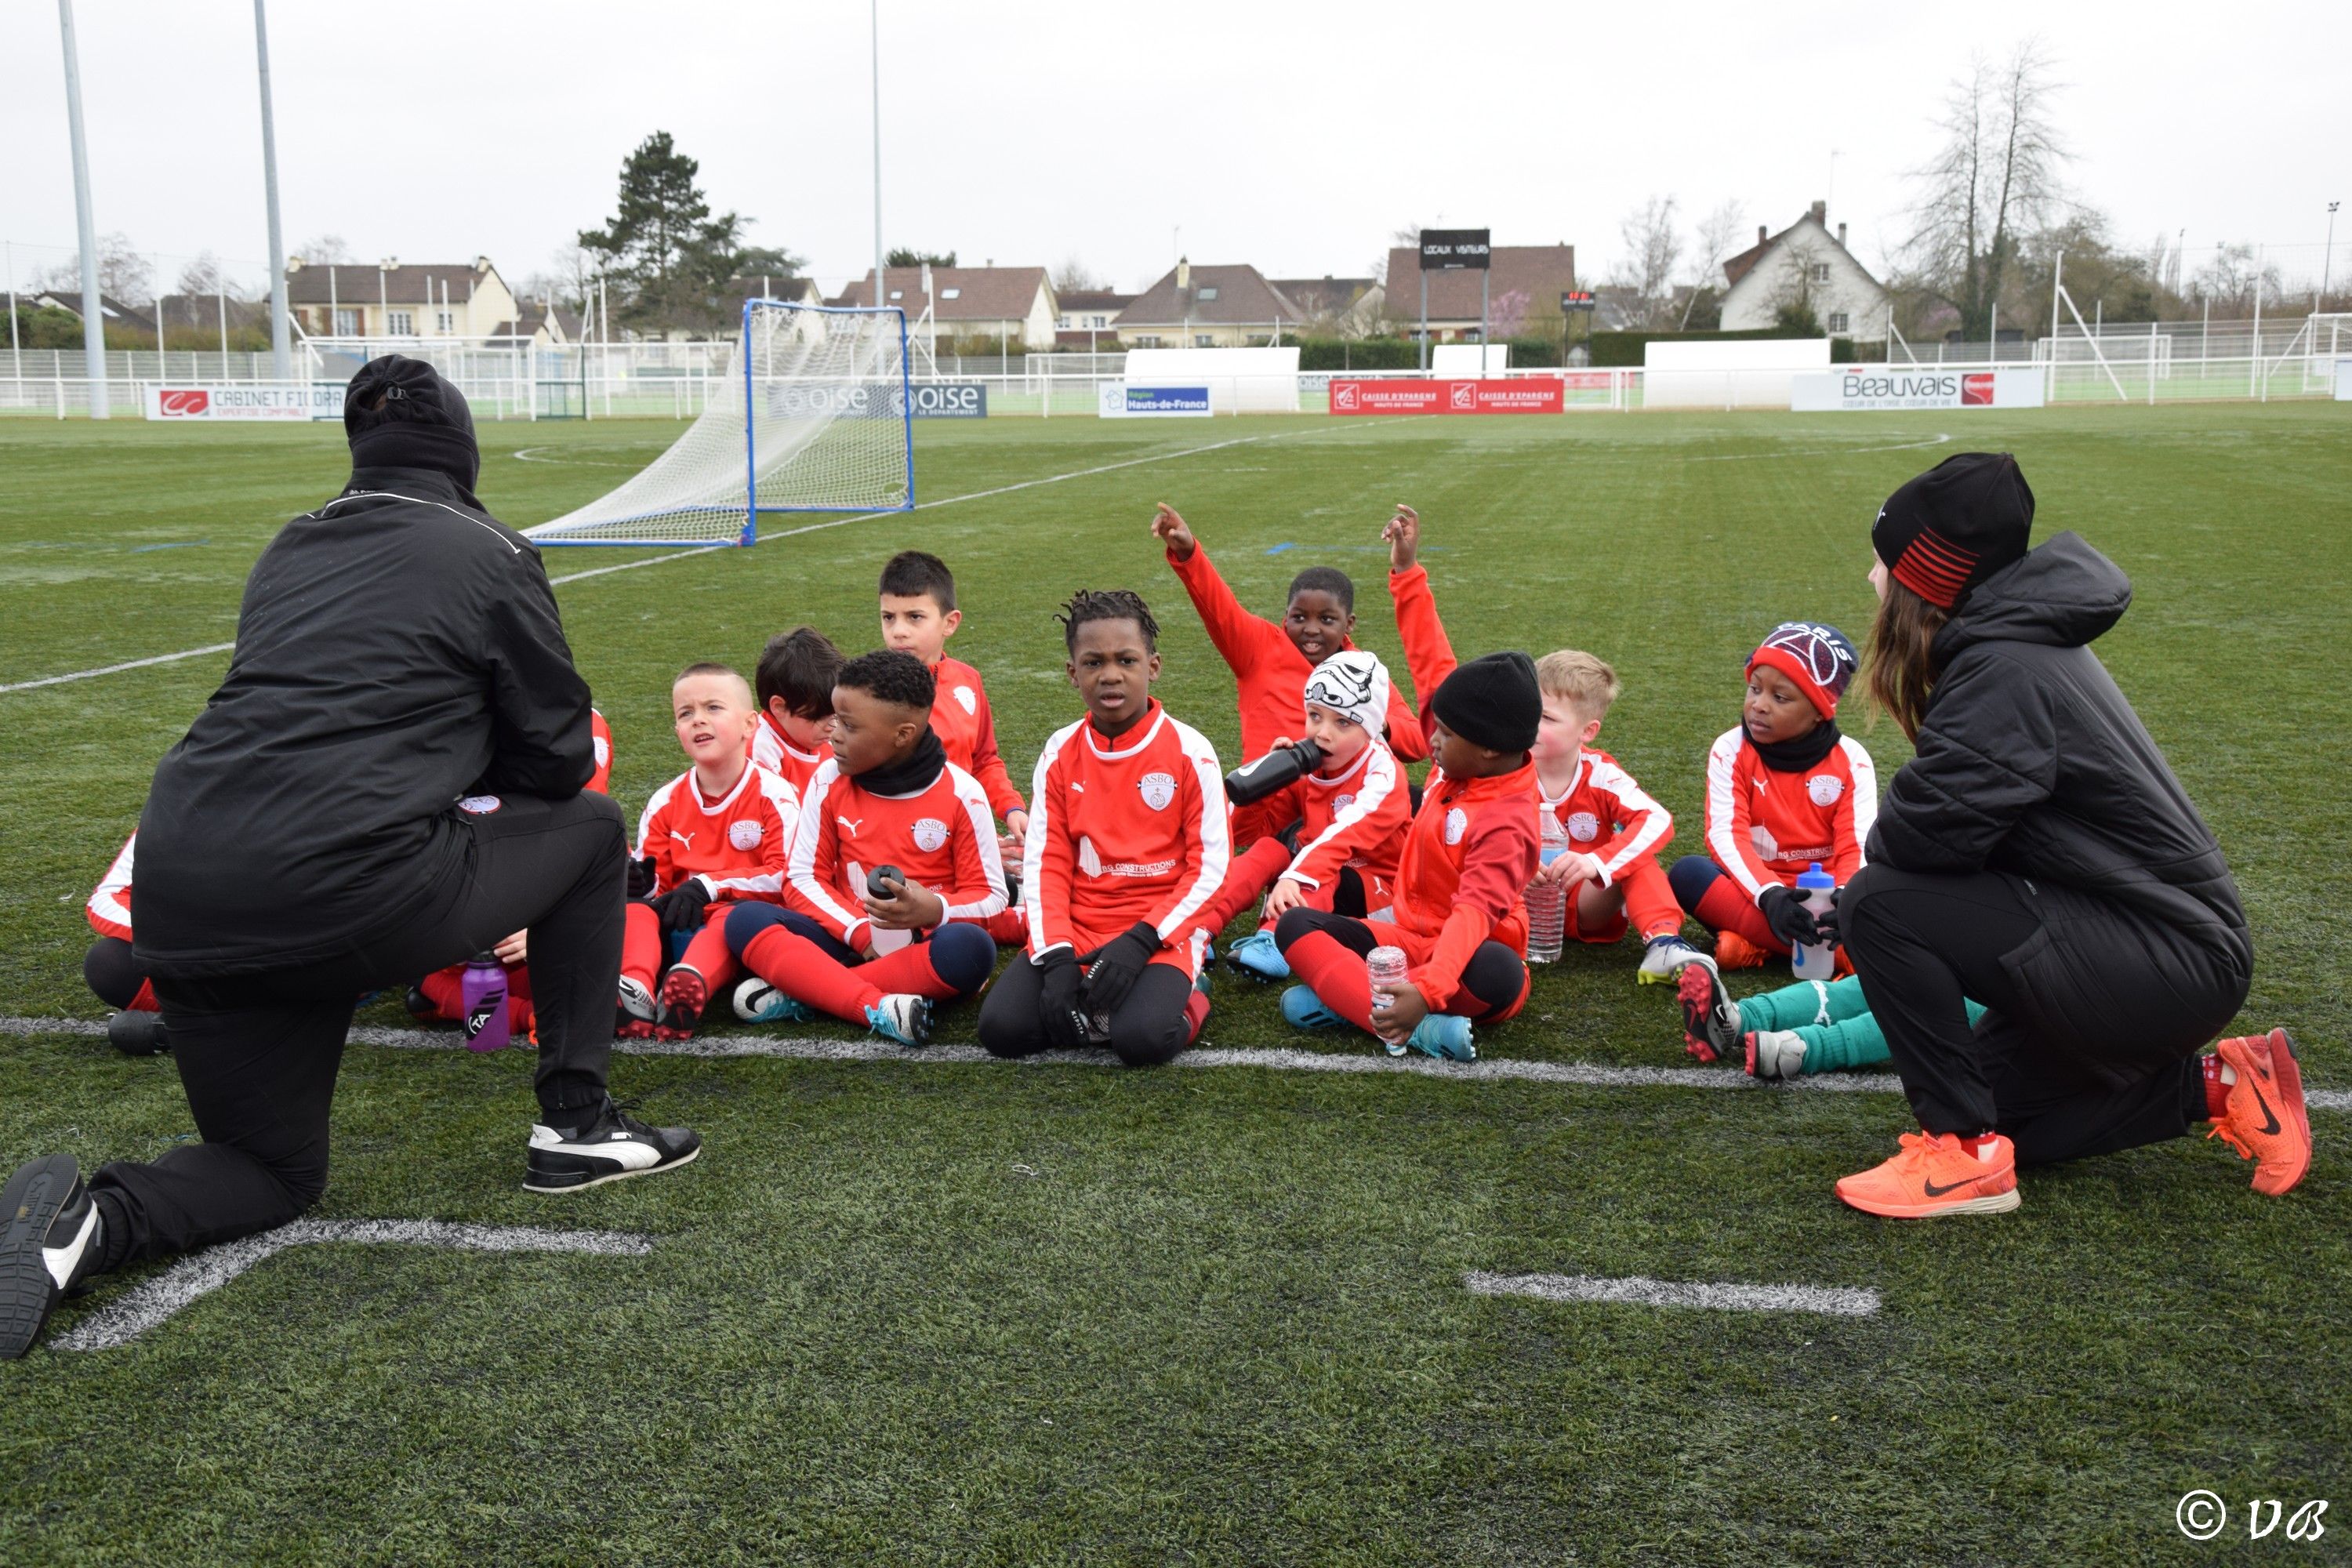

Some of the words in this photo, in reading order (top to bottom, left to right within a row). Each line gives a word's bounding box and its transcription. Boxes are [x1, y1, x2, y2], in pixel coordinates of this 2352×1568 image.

[1424, 245, 1451, 255] LOCAUX
[1843, 376, 1956, 397] Beauvais
[215, 391, 279, 406] CABINET
[1361, 392, 1389, 401] CAISSE
[1479, 391, 1507, 401] CAISSE
[1128, 399, 1207, 409] Hauts-de-France
[1777, 622, 1853, 661] PARIS
[1144, 775, 1172, 785] ASBO
[1813, 776, 1841, 786] ASBO
[1336, 796, 1352, 806] ASB
[1569, 814, 1595, 823] ASBO
[731, 822, 759, 833] ASBO
[918, 819, 946, 831] ASBO
[1115, 859, 1176, 872] CONSTRUCTIONS
